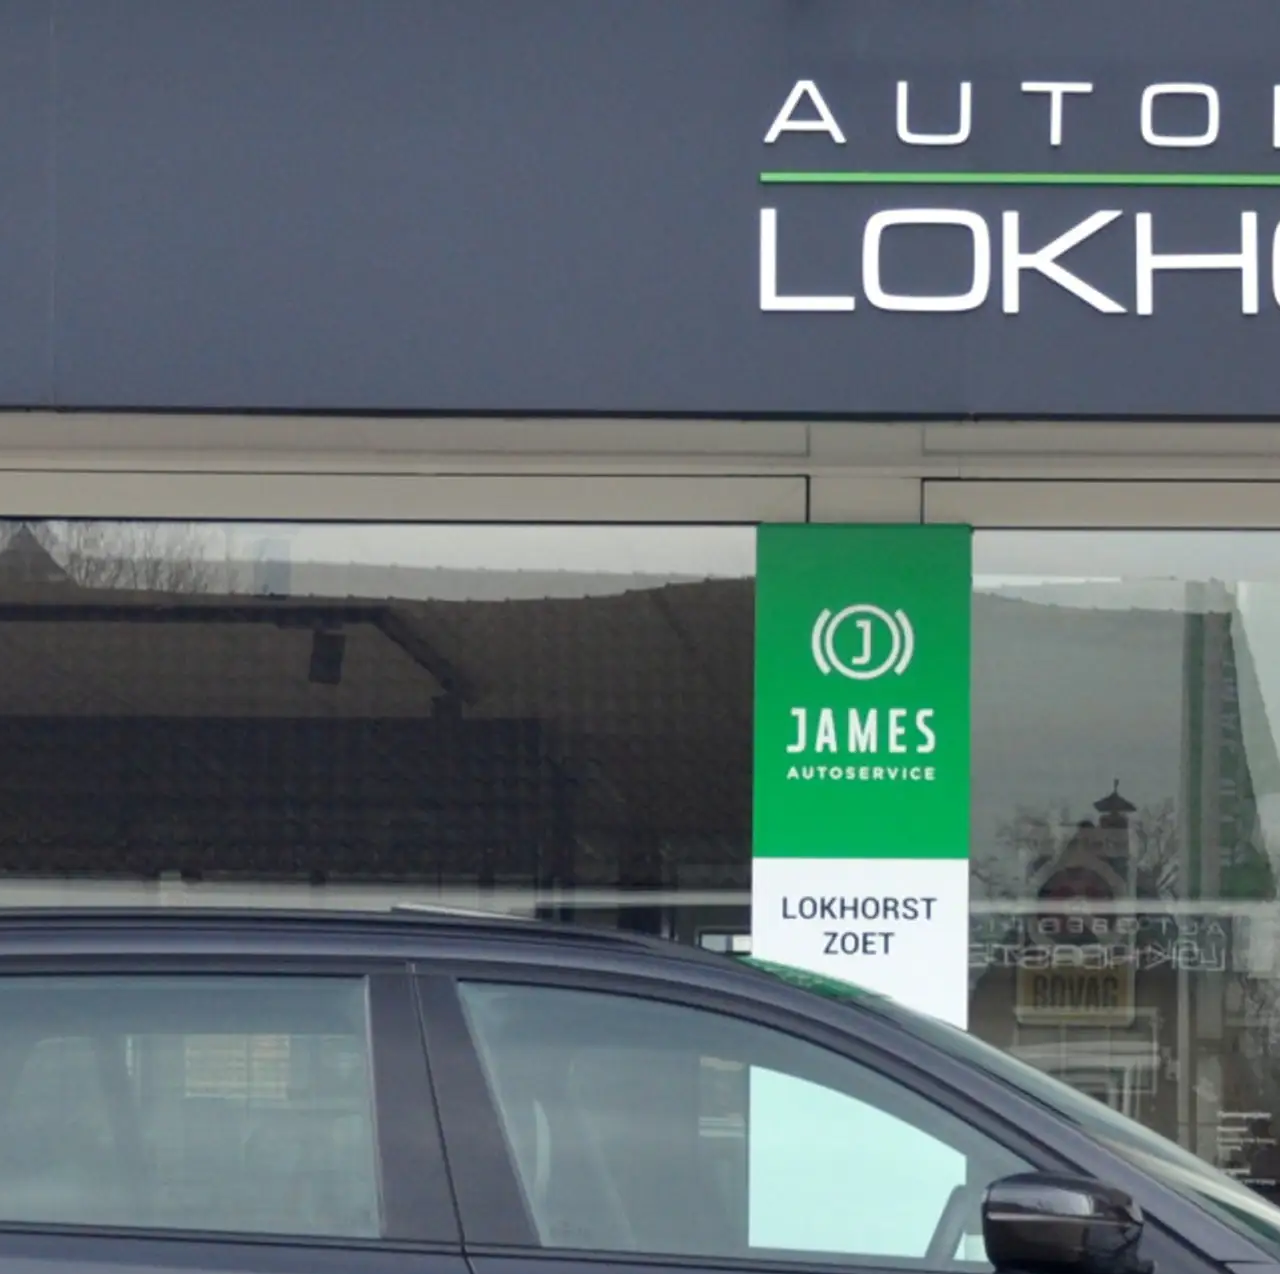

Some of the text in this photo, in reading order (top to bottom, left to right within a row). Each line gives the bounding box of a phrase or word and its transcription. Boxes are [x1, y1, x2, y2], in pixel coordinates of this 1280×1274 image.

[786, 707, 936, 754] JAMES
[786, 766, 936, 781] AUTOSERVICE
[781, 896, 938, 920] LOKHORST
[822, 931, 896, 955] ZOET
